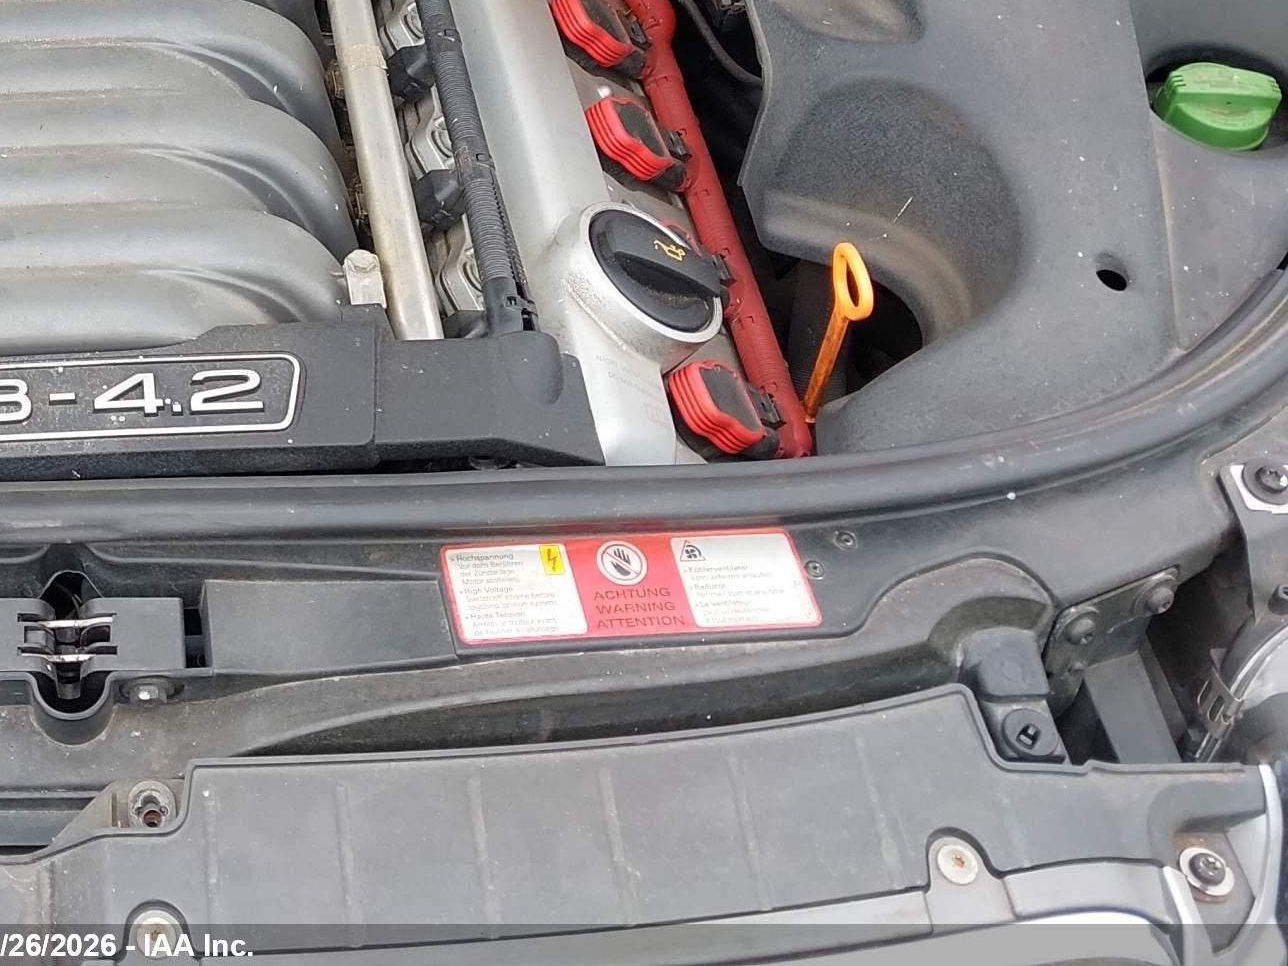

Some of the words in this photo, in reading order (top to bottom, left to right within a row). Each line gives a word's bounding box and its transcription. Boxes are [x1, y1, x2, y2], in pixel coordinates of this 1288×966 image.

[593, 586, 672, 601] ACHTUNG
[595, 600, 676, 615] WARNING
[596, 614, 686, 631] ATTENTION
